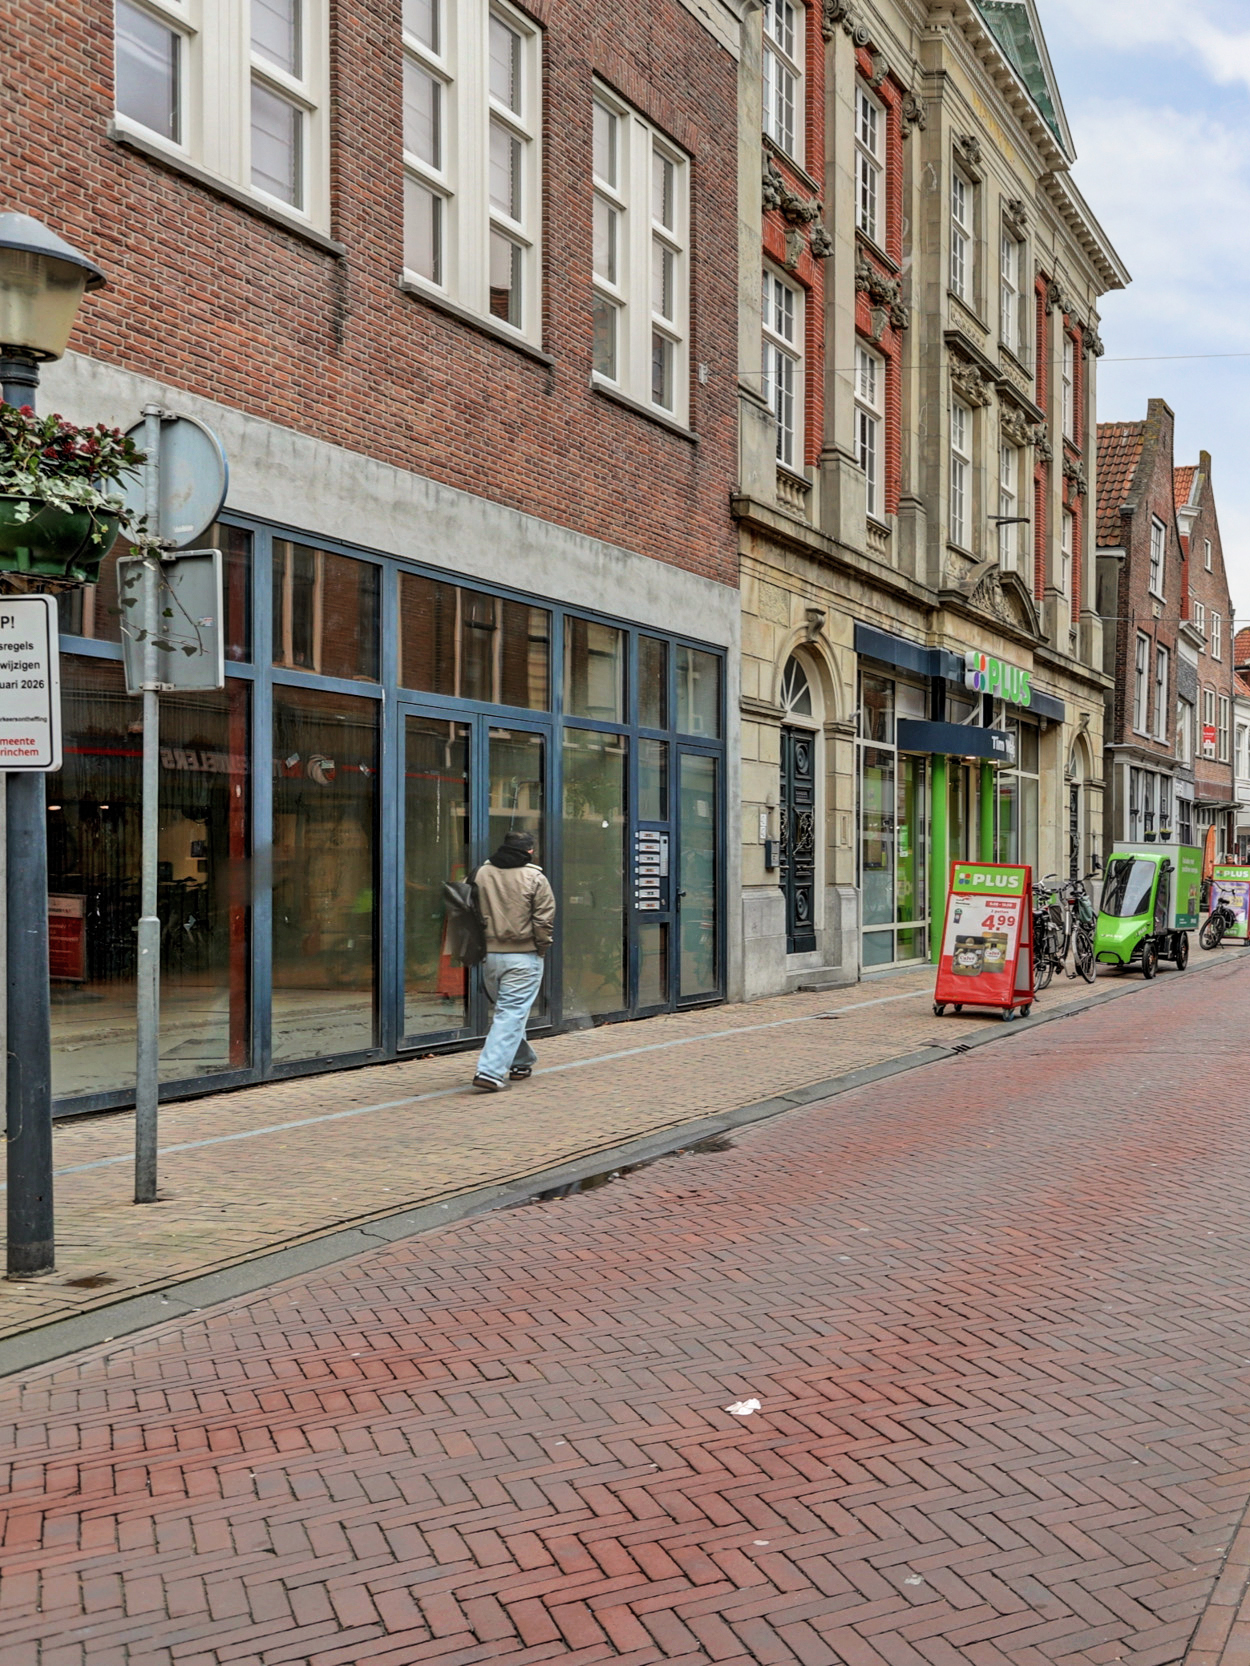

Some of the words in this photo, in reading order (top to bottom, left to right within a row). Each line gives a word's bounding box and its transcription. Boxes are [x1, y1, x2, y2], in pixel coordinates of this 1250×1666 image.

[21, 680, 45, 689] 2026
[987, 656, 1032, 707] PLUS
[972, 873, 1019, 889] PLUS
[1224, 870, 1249, 878] PLUS
[981, 914, 1016, 931] 4.99
